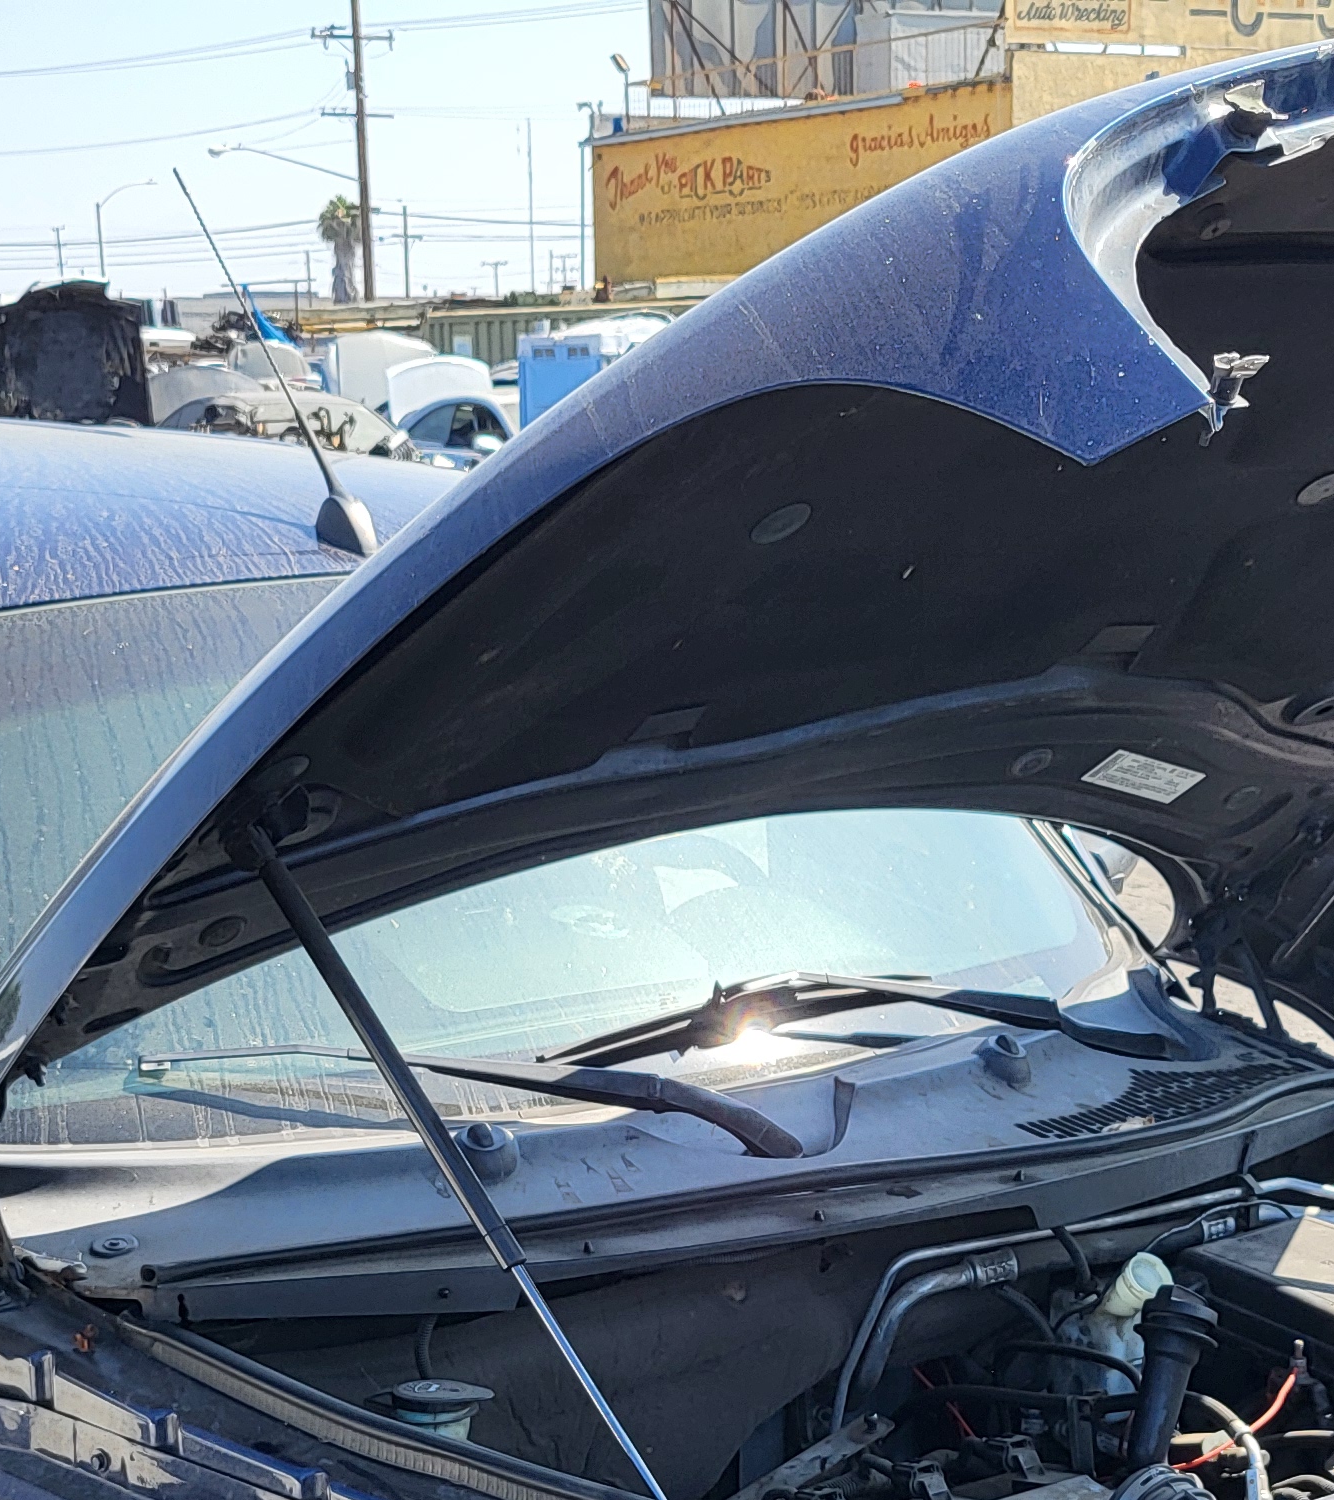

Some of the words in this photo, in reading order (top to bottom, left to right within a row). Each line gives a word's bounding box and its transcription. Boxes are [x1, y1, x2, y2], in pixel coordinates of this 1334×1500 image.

[1018, 2, 1057, 22] Auto
[1059, 2, 1127, 30] Wrecking
[605, 165, 655, 212] Thank
[721, 156, 772, 190] PARTS
